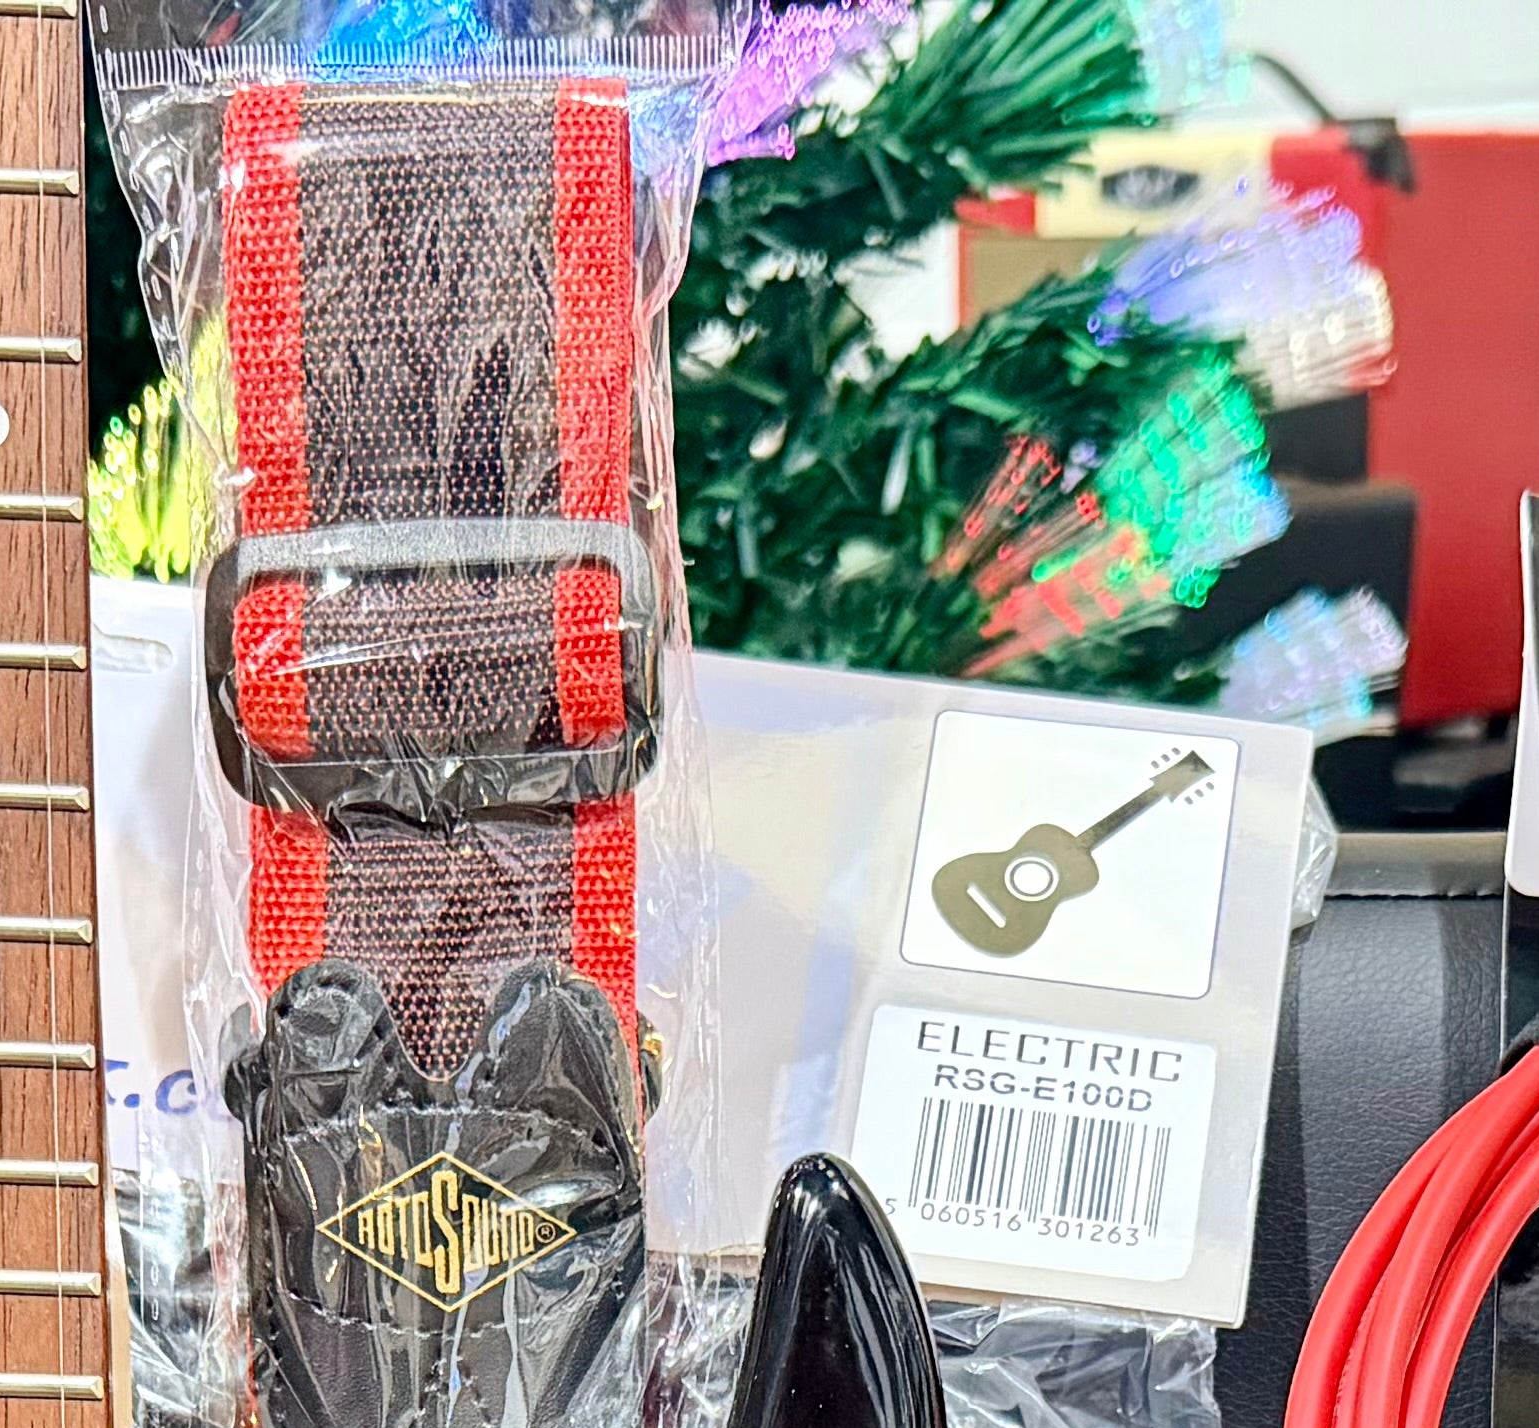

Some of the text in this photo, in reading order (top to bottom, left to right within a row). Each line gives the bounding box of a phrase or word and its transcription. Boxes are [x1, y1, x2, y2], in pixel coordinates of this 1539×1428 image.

[918, 1020, 1182, 1083] ELECTRIC
[933, 1064, 1153, 1113] RSG-E100D
[920, 1202, 1022, 1232] 060516
[1038, 1218, 1139, 1247] 301263
